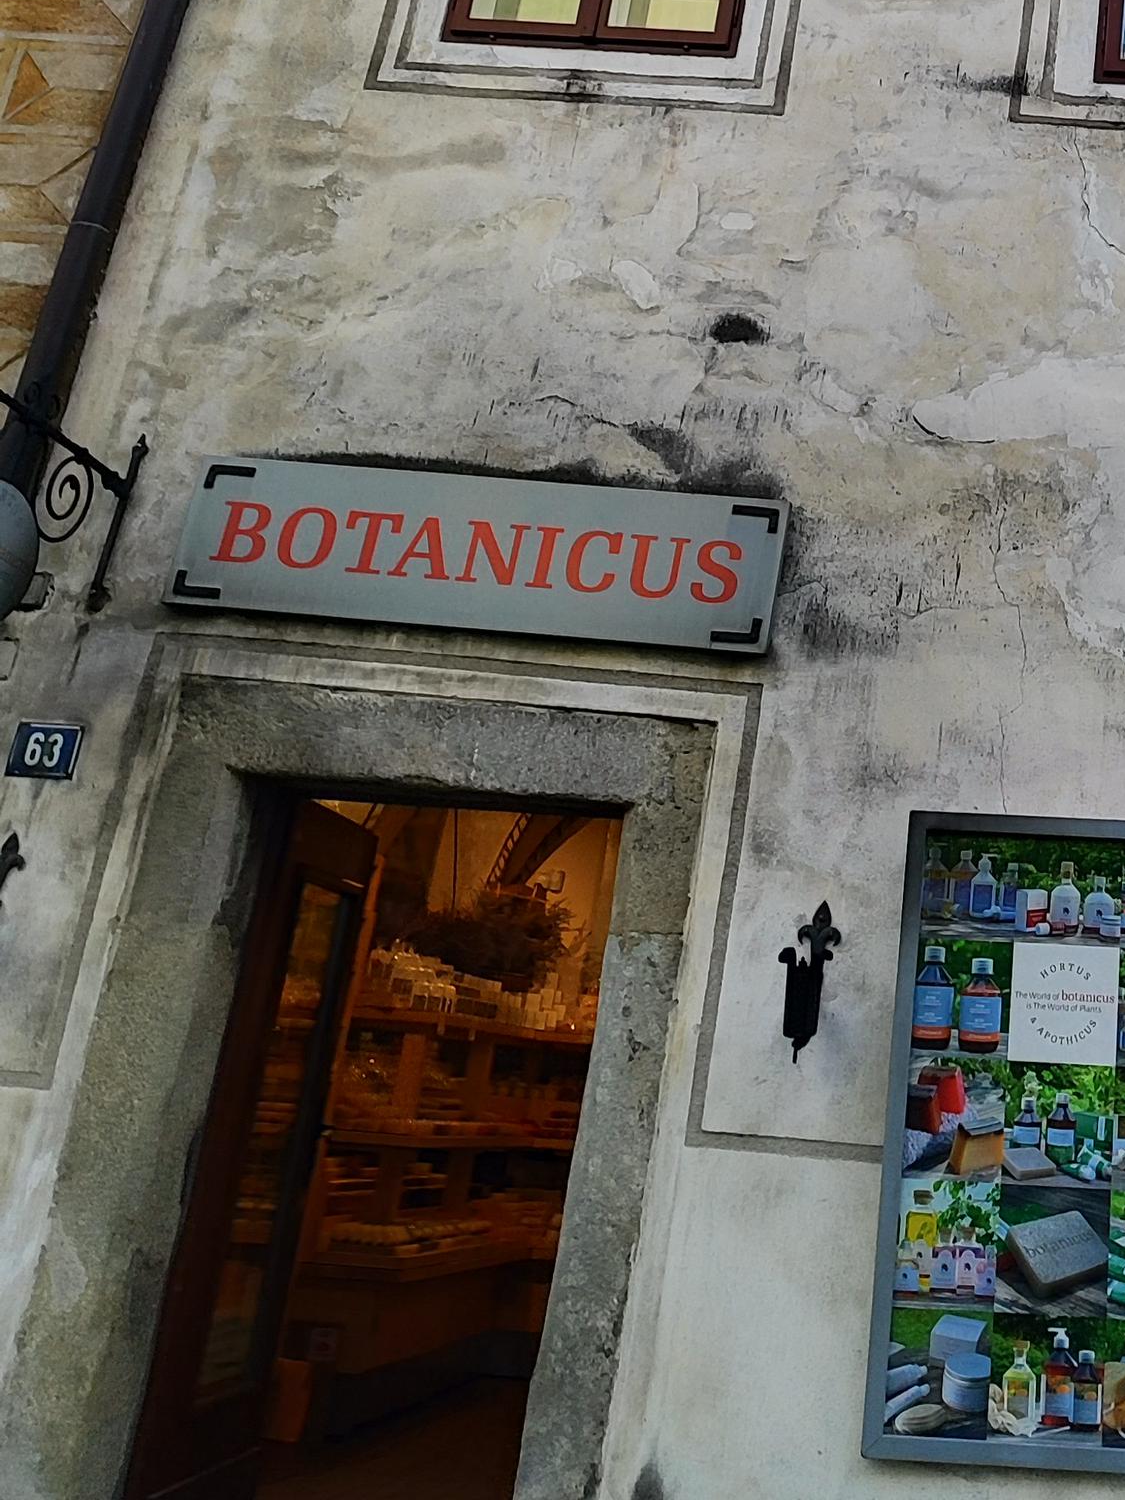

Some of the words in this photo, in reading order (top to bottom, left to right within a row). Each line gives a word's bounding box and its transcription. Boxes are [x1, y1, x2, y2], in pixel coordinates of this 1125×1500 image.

[208, 500, 744, 604] BOTANICUS
[24, 731, 64, 768] 63
[1040, 963, 1091, 980] HORTUS
[1015, 990, 1028, 999] The
[1029, 991, 1051, 1001] World
[1052, 992, 1060, 1001] of
[1061, 989, 1115, 1004] botanicus
[1033, 1001, 1046, 1011] The
[1047, 1003, 1069, 1012] World
[1070, 1004, 1078, 1012] of
[1080, 1005, 1102, 1014] Plants
[1037, 1019, 1097, 1045] APOTHICUS
[1023, 1230, 1094, 1259] botanicus
